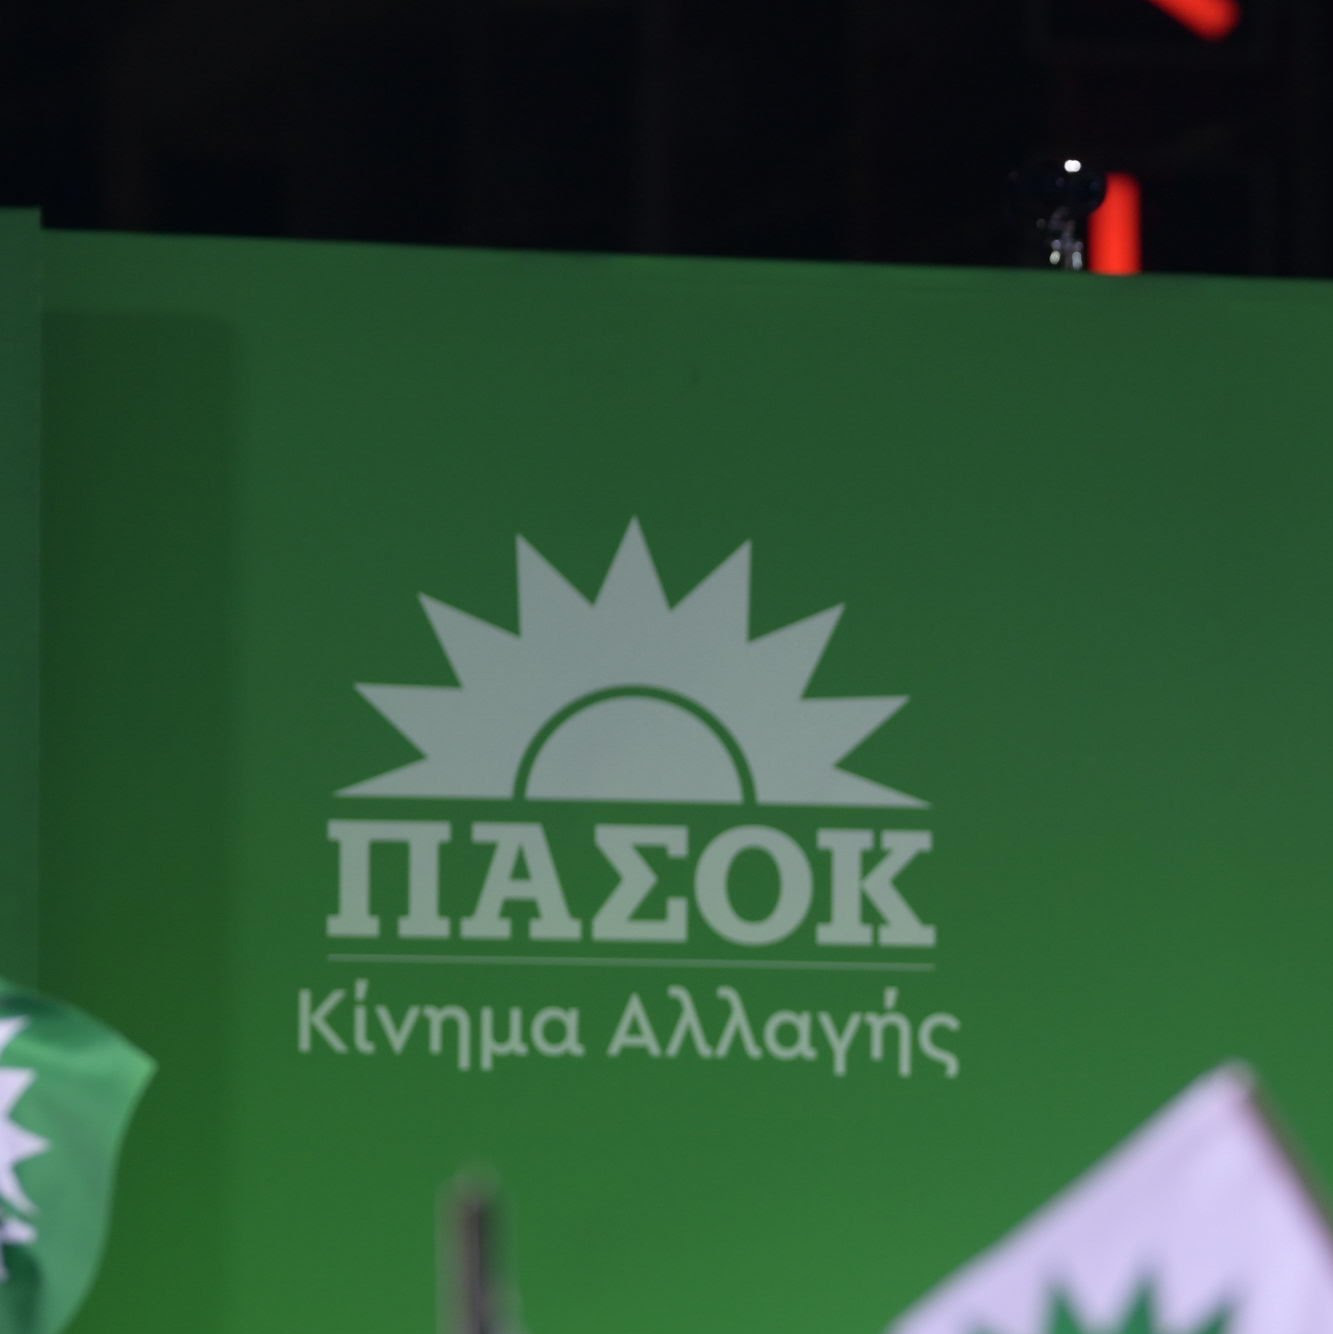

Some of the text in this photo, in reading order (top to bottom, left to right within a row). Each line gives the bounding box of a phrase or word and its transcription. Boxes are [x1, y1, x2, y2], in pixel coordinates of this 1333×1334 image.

[326, 819, 936, 948] ΠΑΣΟΚ
[297, 977, 961, 1078] Κίνημα Αλλαγής
